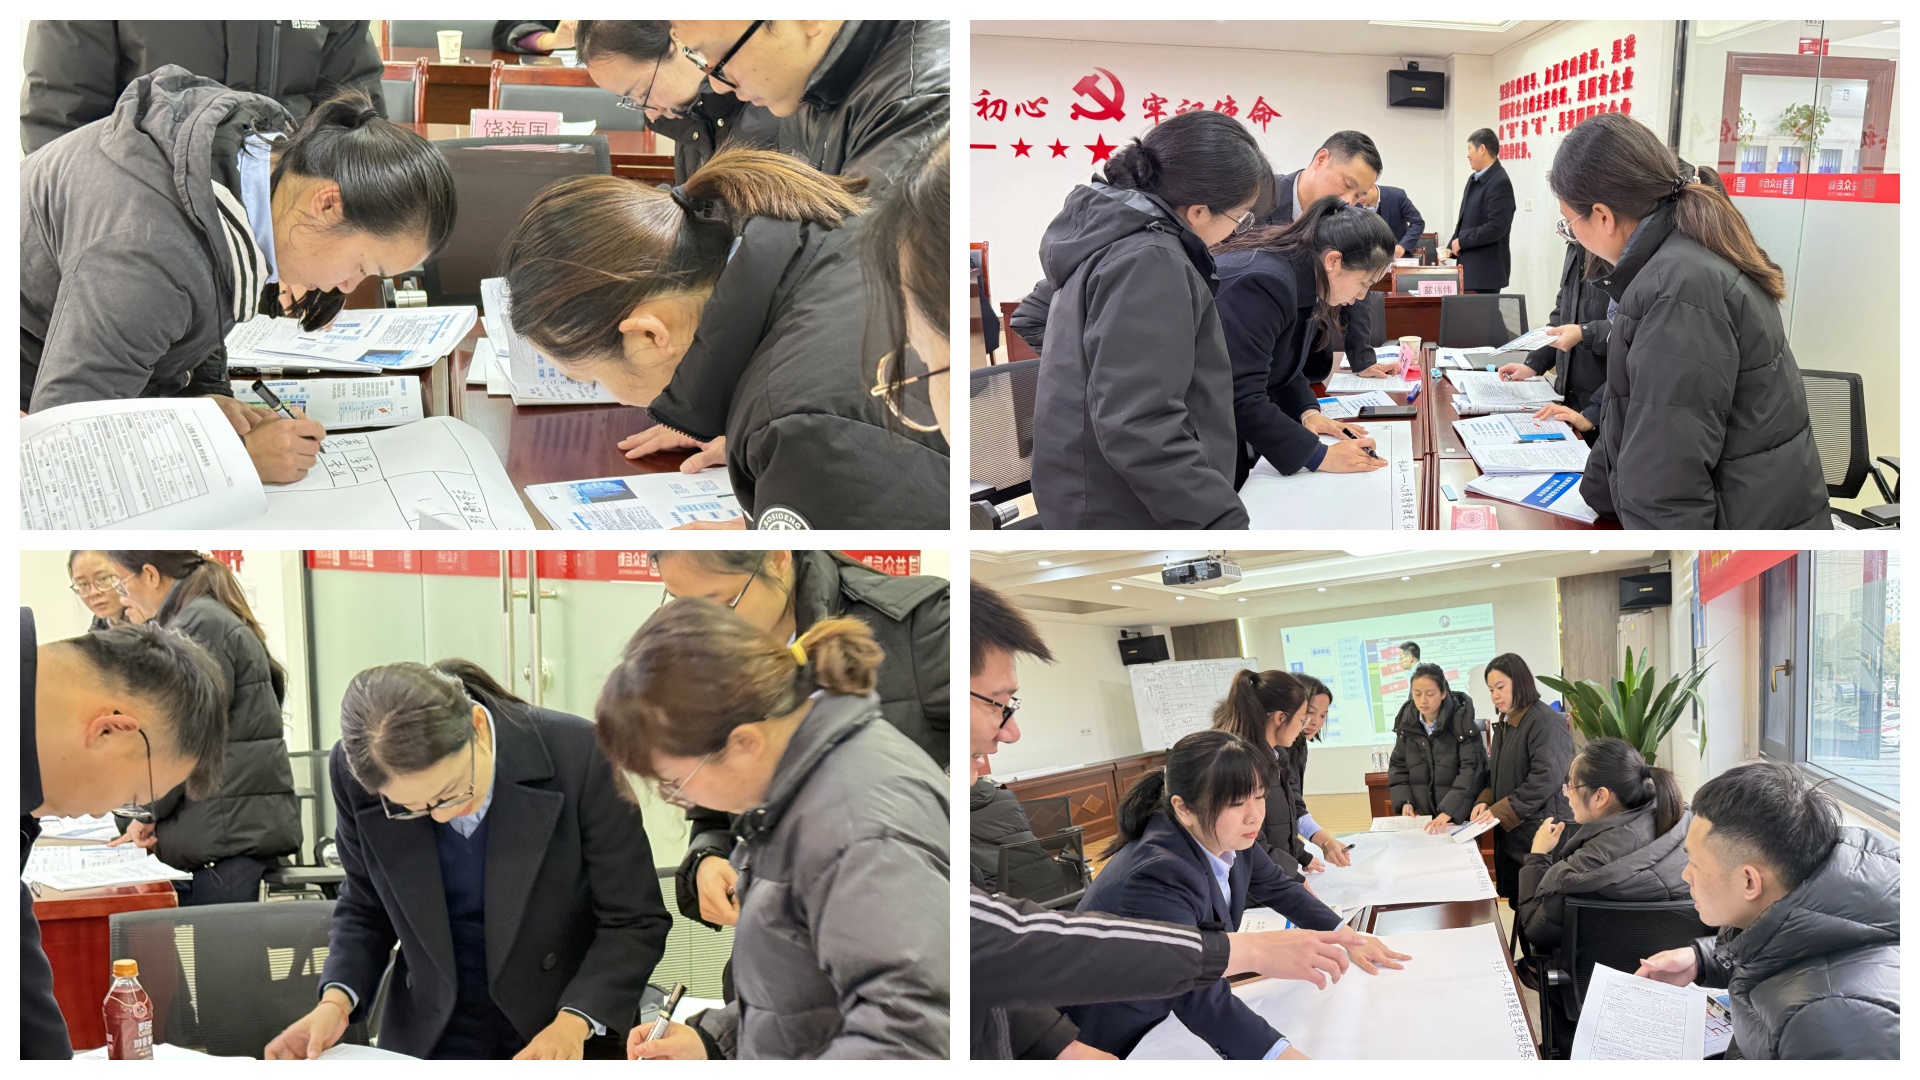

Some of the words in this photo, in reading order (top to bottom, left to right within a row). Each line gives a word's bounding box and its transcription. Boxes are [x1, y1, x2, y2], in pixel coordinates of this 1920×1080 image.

[971, 89, 1049, 122] 初心
[484, 119, 548, 138] 饶海国
[763, 512, 802, 530] BOSIDENG
